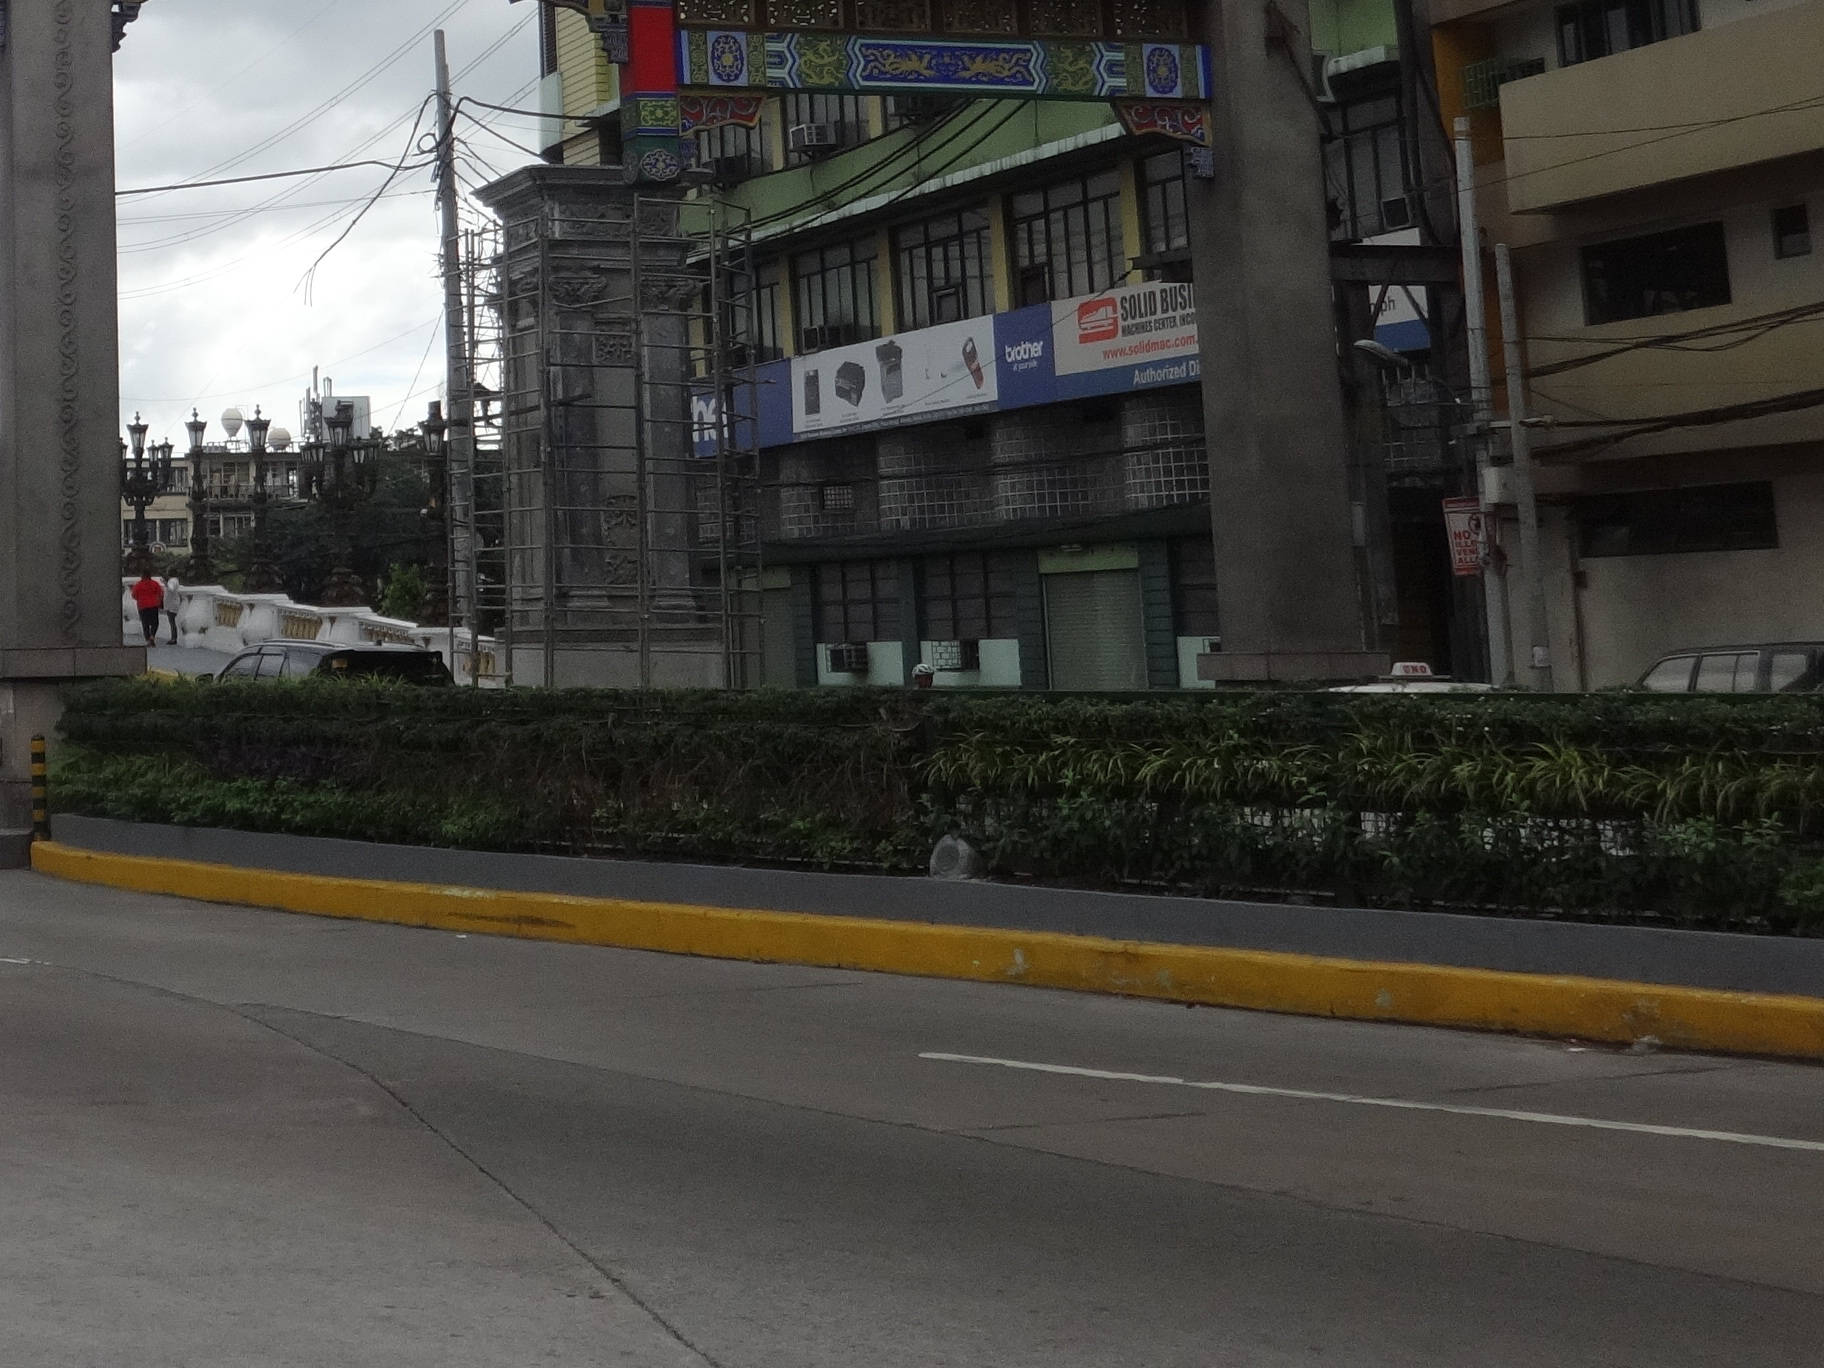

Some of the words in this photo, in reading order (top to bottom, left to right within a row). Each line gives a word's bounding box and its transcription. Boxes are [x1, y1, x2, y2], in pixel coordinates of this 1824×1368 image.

[1120, 290, 1157, 322] SOLID
[1160, 283, 1194, 314] BUSI
[1004, 340, 1044, 363] brother
[1133, 363, 1187, 385] Authorized
[1453, 530, 1471, 540] NO
